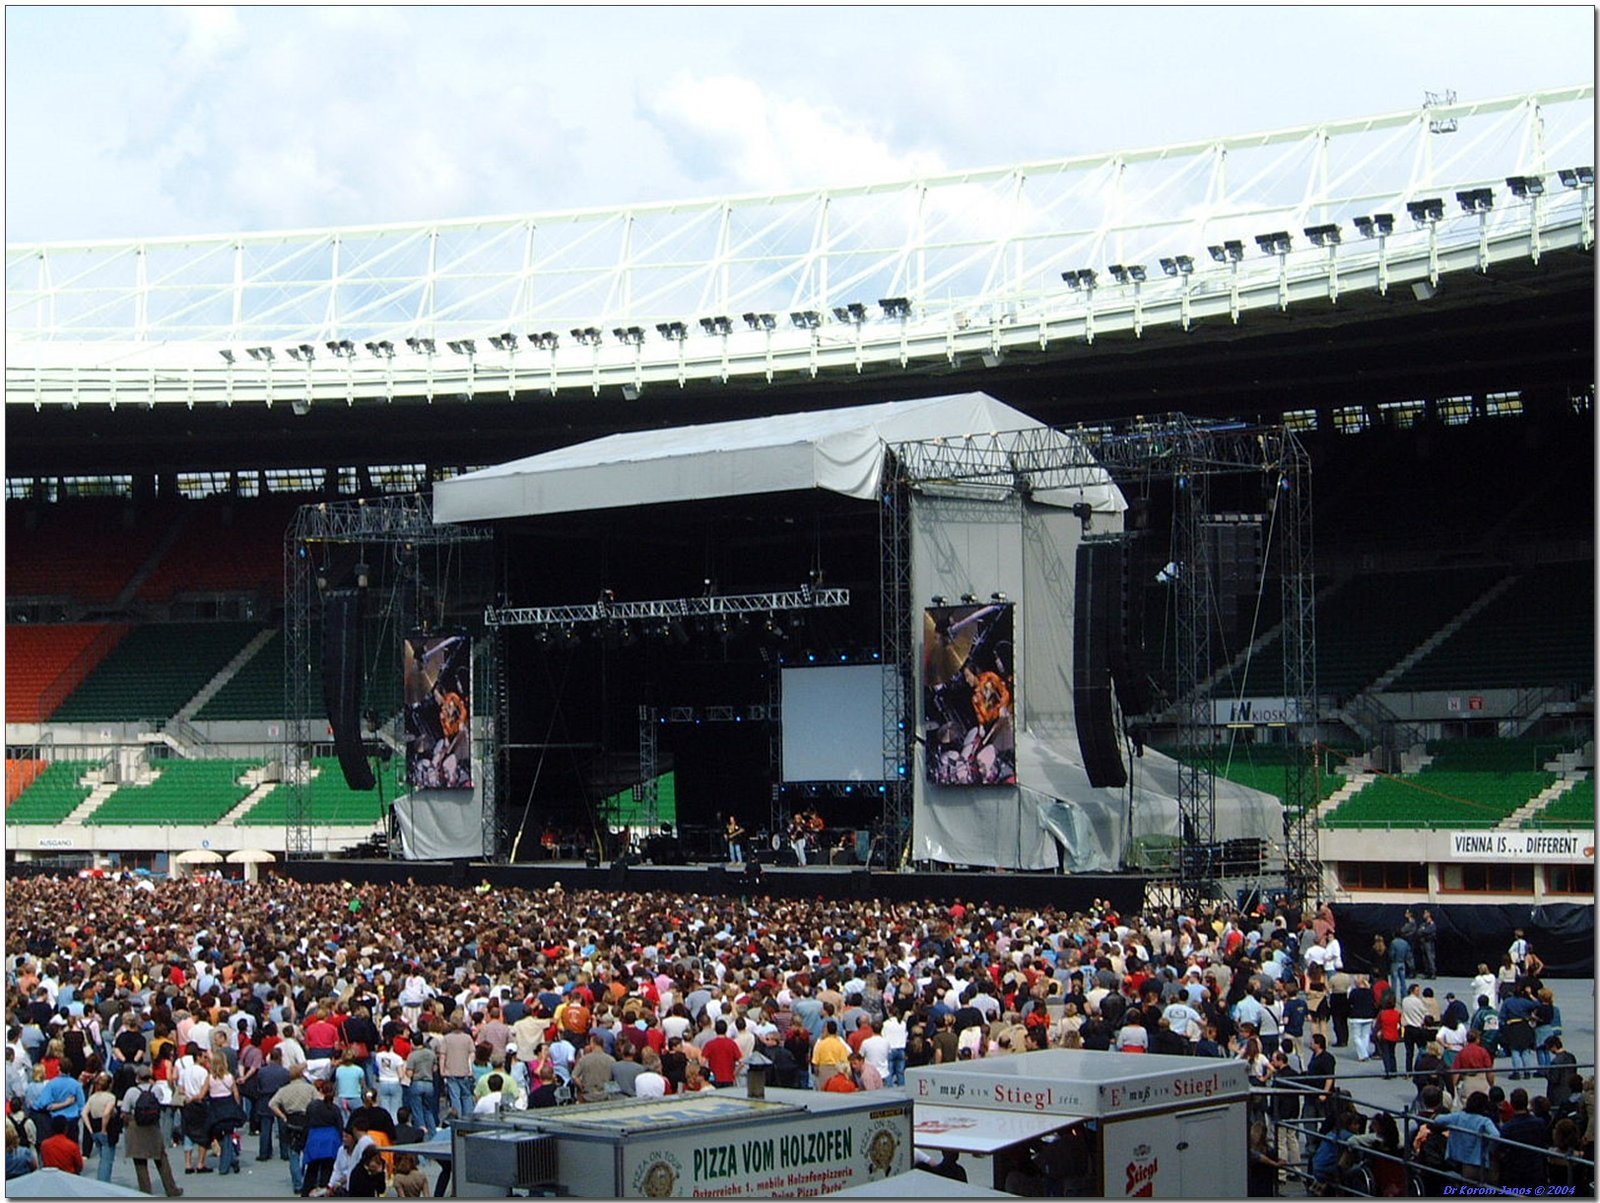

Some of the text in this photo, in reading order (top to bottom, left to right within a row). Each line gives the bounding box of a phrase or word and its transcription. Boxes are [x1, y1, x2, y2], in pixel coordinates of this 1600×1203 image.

[1455, 836, 1579, 854] VIENNA IS... DIFFERENT
[940, 1084, 966, 1099] muß
[994, 1084, 1053, 1110] Stiegl
[1174, 1073, 1219, 1098] Stiegl
[693, 1144, 738, 1182] PIZZA
[742, 1139, 775, 1174] VOM
[780, 1127, 853, 1168] HOLZOFEN
[746, 1182, 754, 1193] 1.
[757, 1175, 785, 1191] mobile
[787, 1166, 854, 1187] Holzofenpizzeria
[1125, 1156, 1158, 1196] Stiegl
